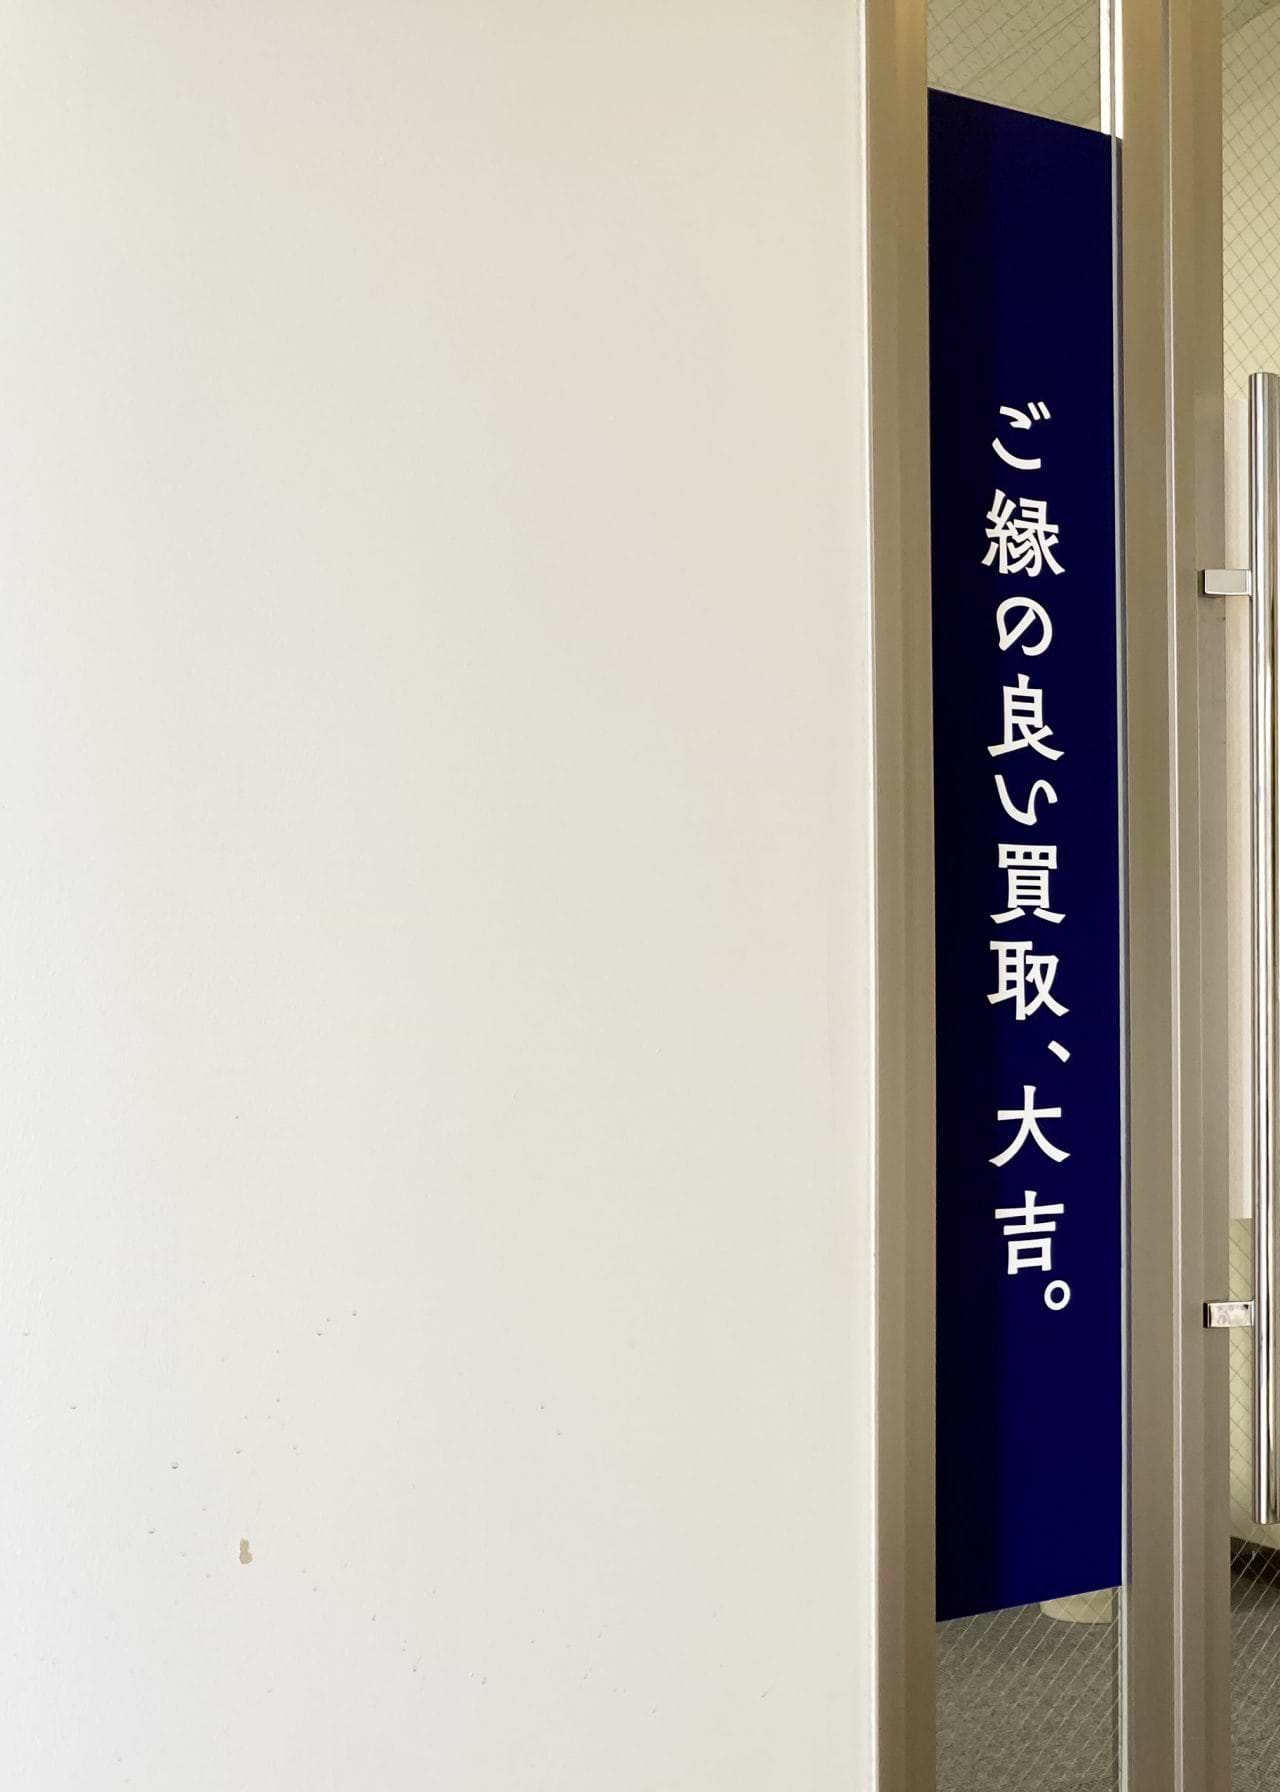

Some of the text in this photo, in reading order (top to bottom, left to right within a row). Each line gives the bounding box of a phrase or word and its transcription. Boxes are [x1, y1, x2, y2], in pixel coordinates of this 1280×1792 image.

[982, 402, 1071, 1311] ご縁の良い買取、大吉。
